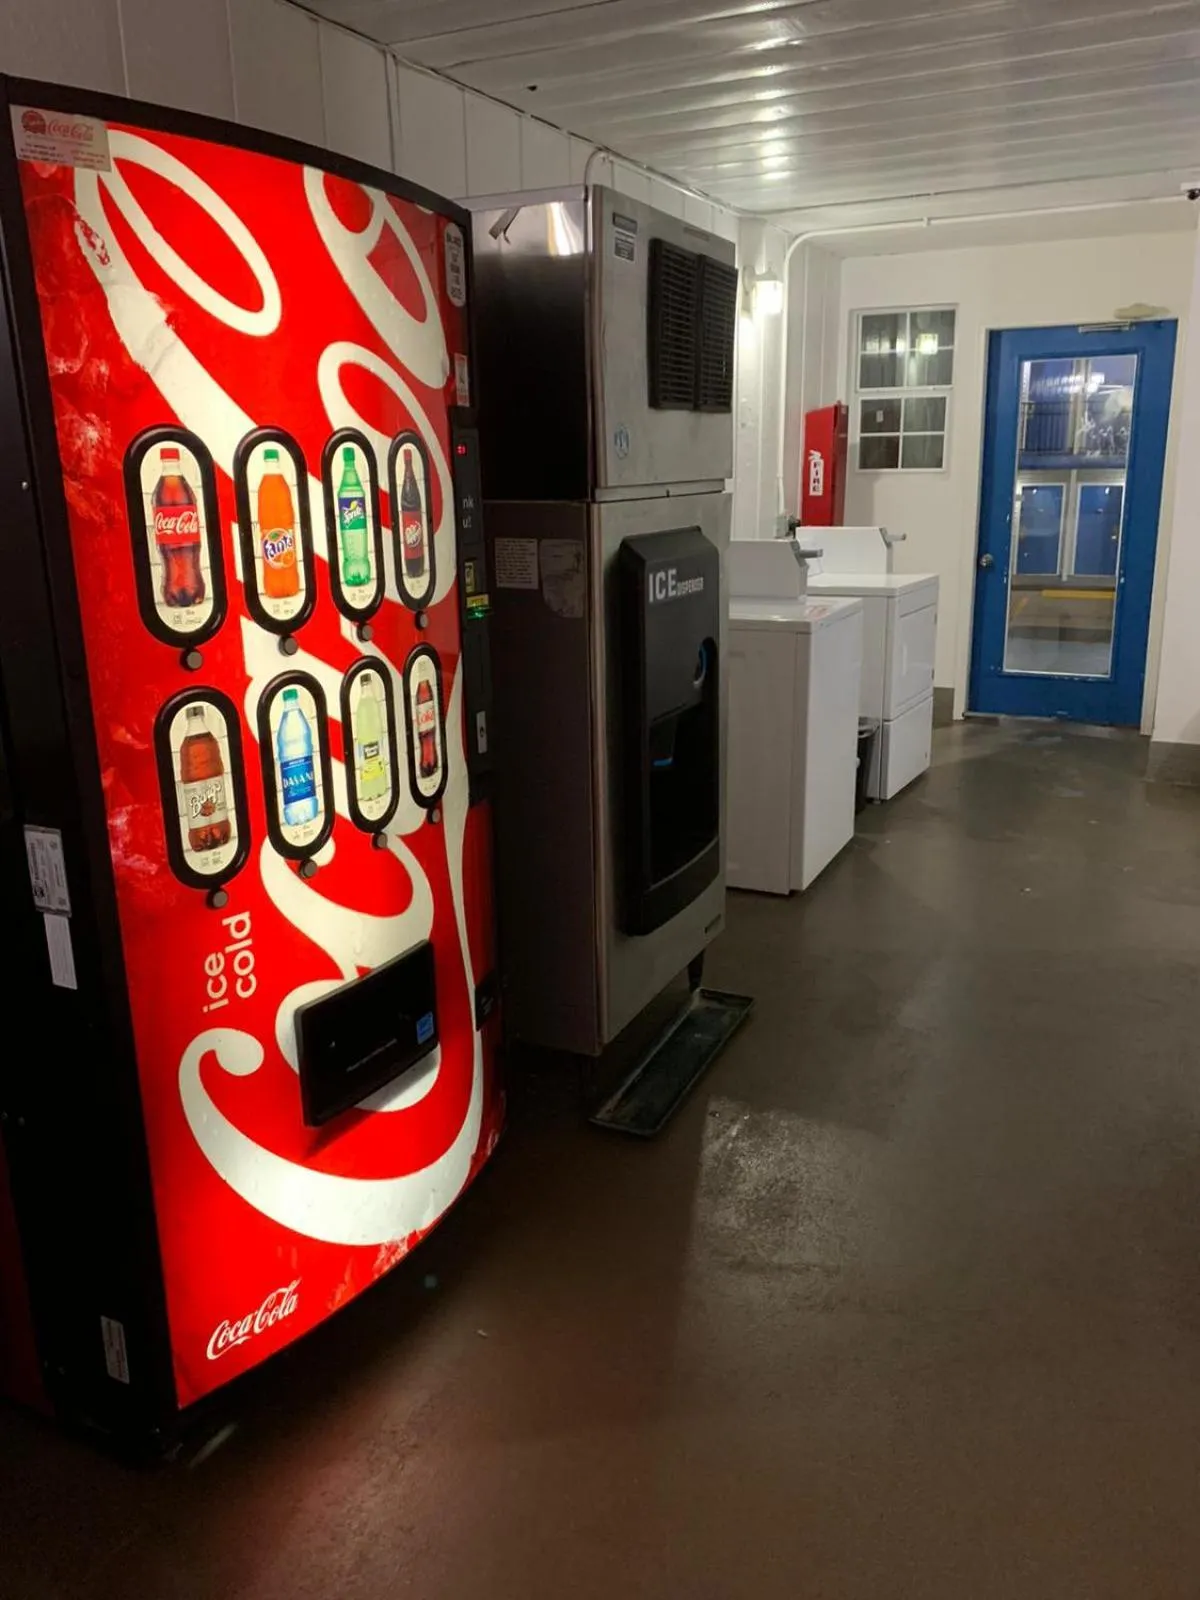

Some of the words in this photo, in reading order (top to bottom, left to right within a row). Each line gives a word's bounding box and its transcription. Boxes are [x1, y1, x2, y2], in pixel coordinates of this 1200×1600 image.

[155, 511, 198, 535] Coca-Cola
[649, 568, 677, 603] ICE
[202, 951, 229, 1014] ice
[221, 910, 257, 999] cold
[206, 1276, 302, 1360] Coca-Cola
